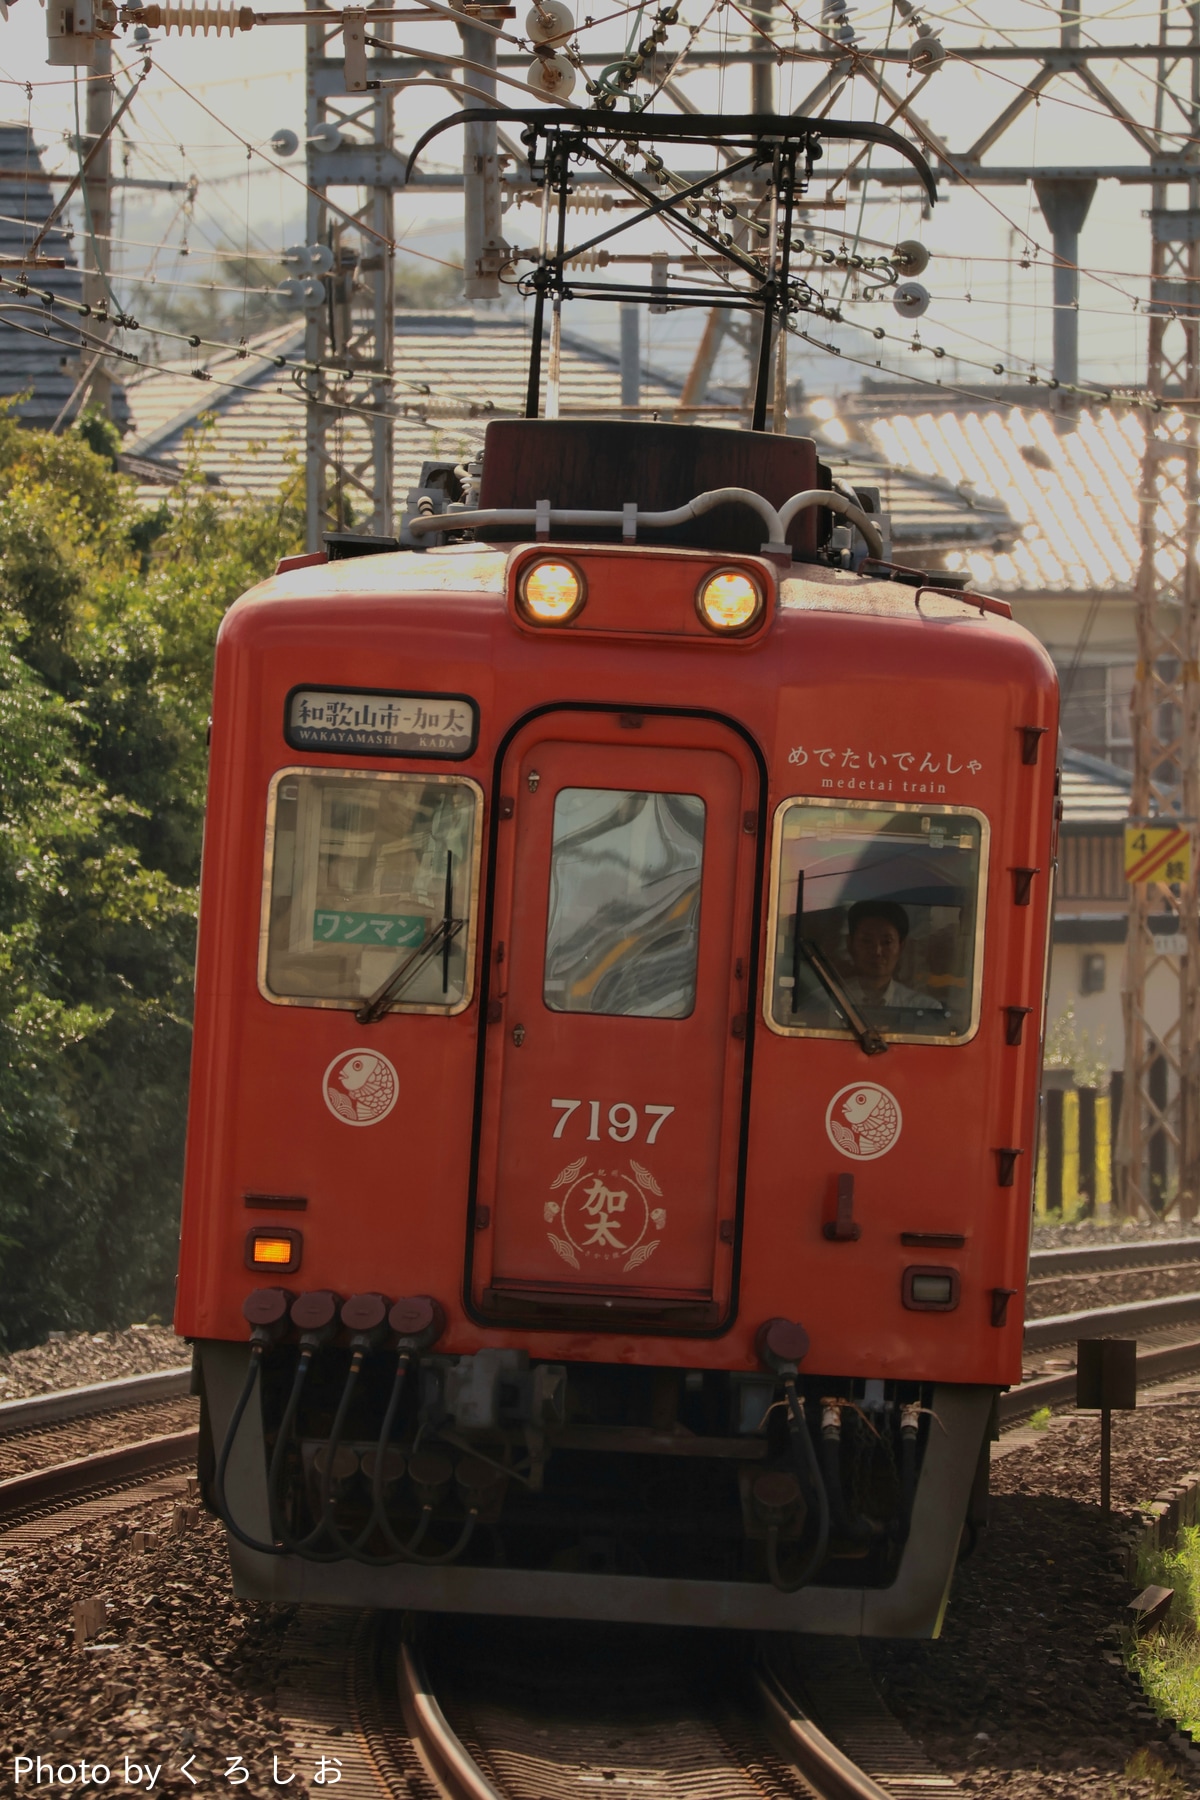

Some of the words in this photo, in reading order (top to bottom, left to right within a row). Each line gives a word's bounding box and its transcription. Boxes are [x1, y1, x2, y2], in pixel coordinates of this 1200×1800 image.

[300, 730, 398, 745] WAKAYAMASHI
[419, 737, 455, 748] KADA
[788, 746, 983, 775] めでたいでんしゃ
[821, 777, 893, 791] medetai
[903, 782, 947, 794] train
[1131, 833, 1147, 853] 4
[317, 913, 421, 944] ワンマン
[551, 1098, 676, 1145] 7197
[579, 1178, 629, 1249] 加太
